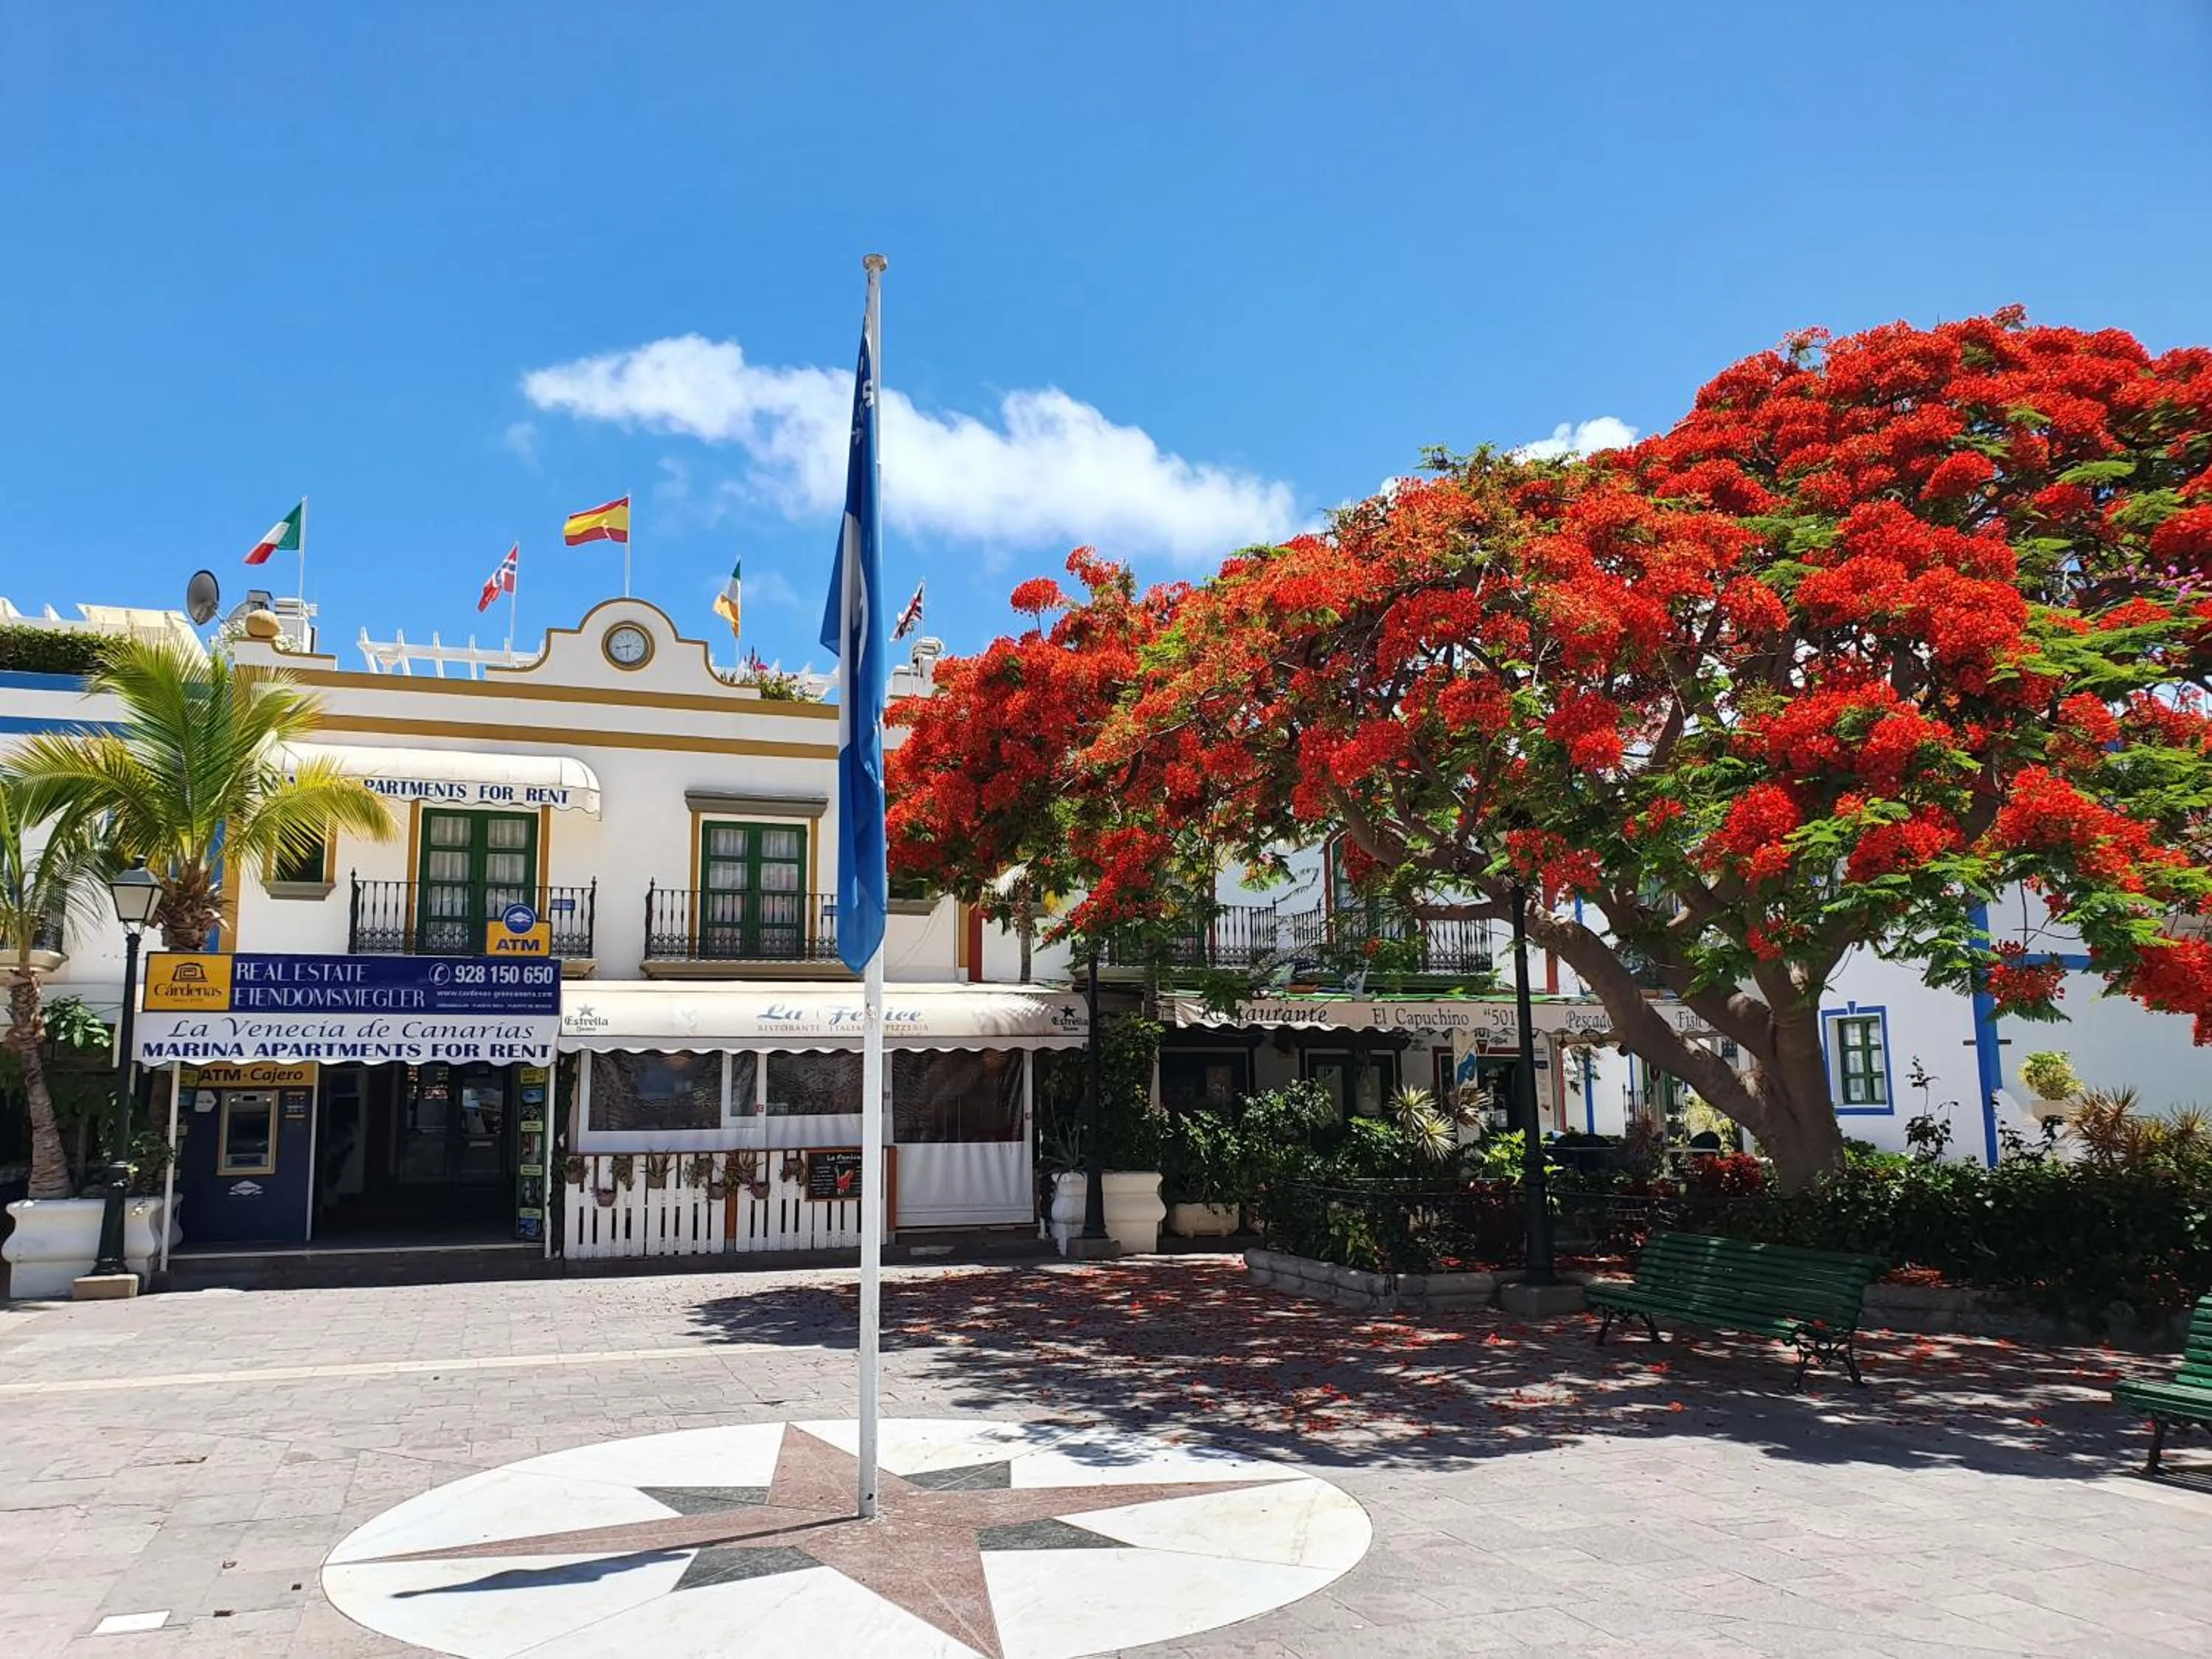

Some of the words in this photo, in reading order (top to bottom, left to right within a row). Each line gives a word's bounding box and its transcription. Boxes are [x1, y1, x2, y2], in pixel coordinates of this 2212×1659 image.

[364, 779, 467, 799] PARTMENTS
[479, 785, 513, 800] FOR
[525, 788, 569, 804] RENT
[495, 939, 540, 951] ATM
[236, 962, 291, 981] REAL
[294, 963, 369, 982] ESTATE
[454, 964, 485, 984] 928
[490, 965, 520, 984] 150
[523, 966, 553, 984] 650
[153, 982, 222, 997] Cárdenas
[234, 987, 425, 1008] EIENDOMSMEGLER
[564, 1015, 608, 1026] Estrella
[757, 1004, 803, 1020] La
[826, 1005, 921, 1025] Feice
[1197, 1004, 1328, 1026] Retaurante
[1372, 1008, 1386, 1026] El
[1394, 1008, 1470, 1029] Capuchino
[167, 1019, 208, 1037] La
[357, 1018, 390, 1038] de
[758, 1024, 821, 1032] RISTORANTE
[142, 1042, 244, 1057] MARINA
[254, 1042, 421, 1058] APARTMENTS
[431, 1043, 480, 1058] FOR
[490, 1043, 553, 1059] RENT
[199, 1068, 241, 1081] ATM
[250, 1067, 304, 1083] Cajero
